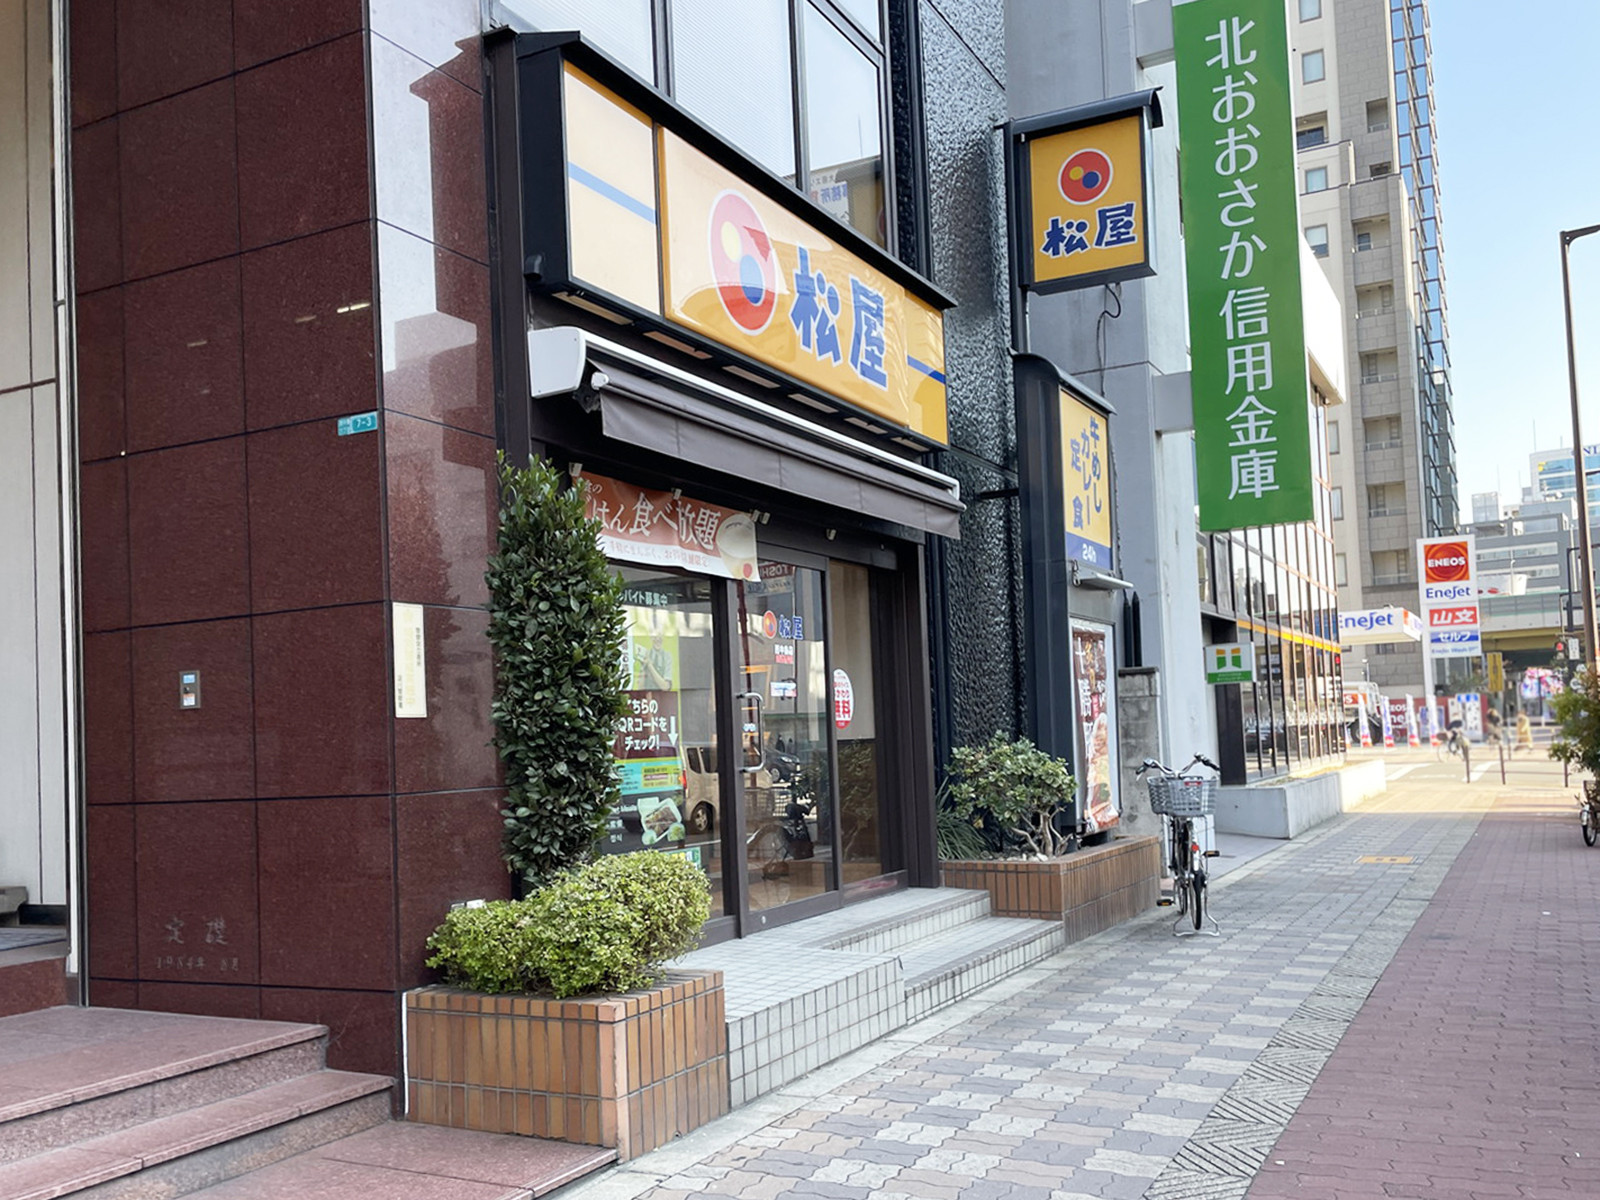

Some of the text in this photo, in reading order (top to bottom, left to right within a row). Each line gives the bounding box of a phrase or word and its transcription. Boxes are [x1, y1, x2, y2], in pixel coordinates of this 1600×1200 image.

[1040, 202, 1137, 259] 松屋
[1204, 15, 1280, 501] 北おおさか信用金庫
[788, 242, 888, 391] 松屋
[355, 416, 372, 428] 7-3
[1080, 427, 1092, 527] カレー
[1090, 414, 1102, 514] 牛めし
[1070, 437, 1084, 531] 定食
[585, 491, 721, 550] はん食べ放題
[1081, 543, 1097, 563] 24h
[1427, 556, 1466, 568] ENEOS
[1426, 586, 1471, 599] EneJet
[779, 614, 803, 640] 松屋
[1432, 609, 1475, 624] 山文
[1438, 631, 1471, 642] セルフ
[627, 698, 658, 714] ちらの
